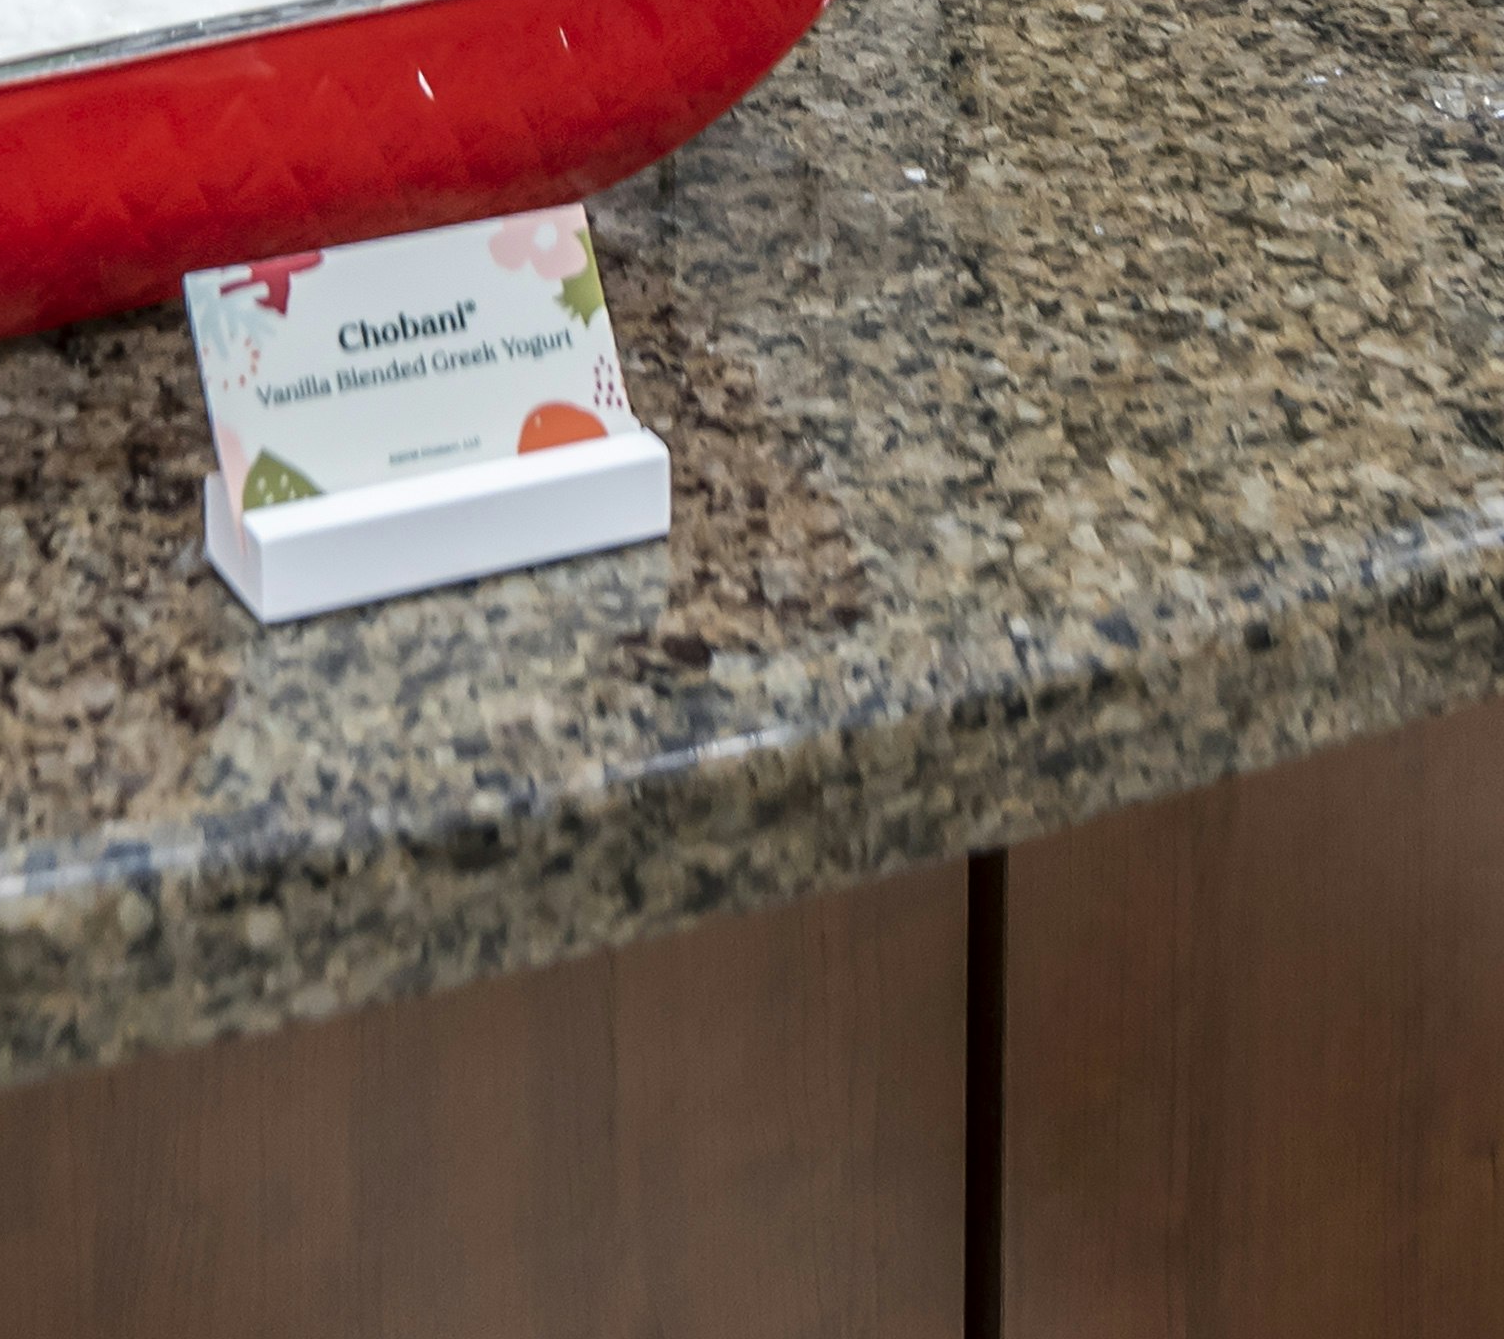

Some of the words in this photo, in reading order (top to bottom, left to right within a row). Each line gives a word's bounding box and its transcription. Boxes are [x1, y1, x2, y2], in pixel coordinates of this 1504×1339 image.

[256, 374, 332, 408] Vanilla
[336, 354, 428, 393] Blended
[432, 339, 498, 371] Greek
[500, 326, 574, 362] Yogurt
